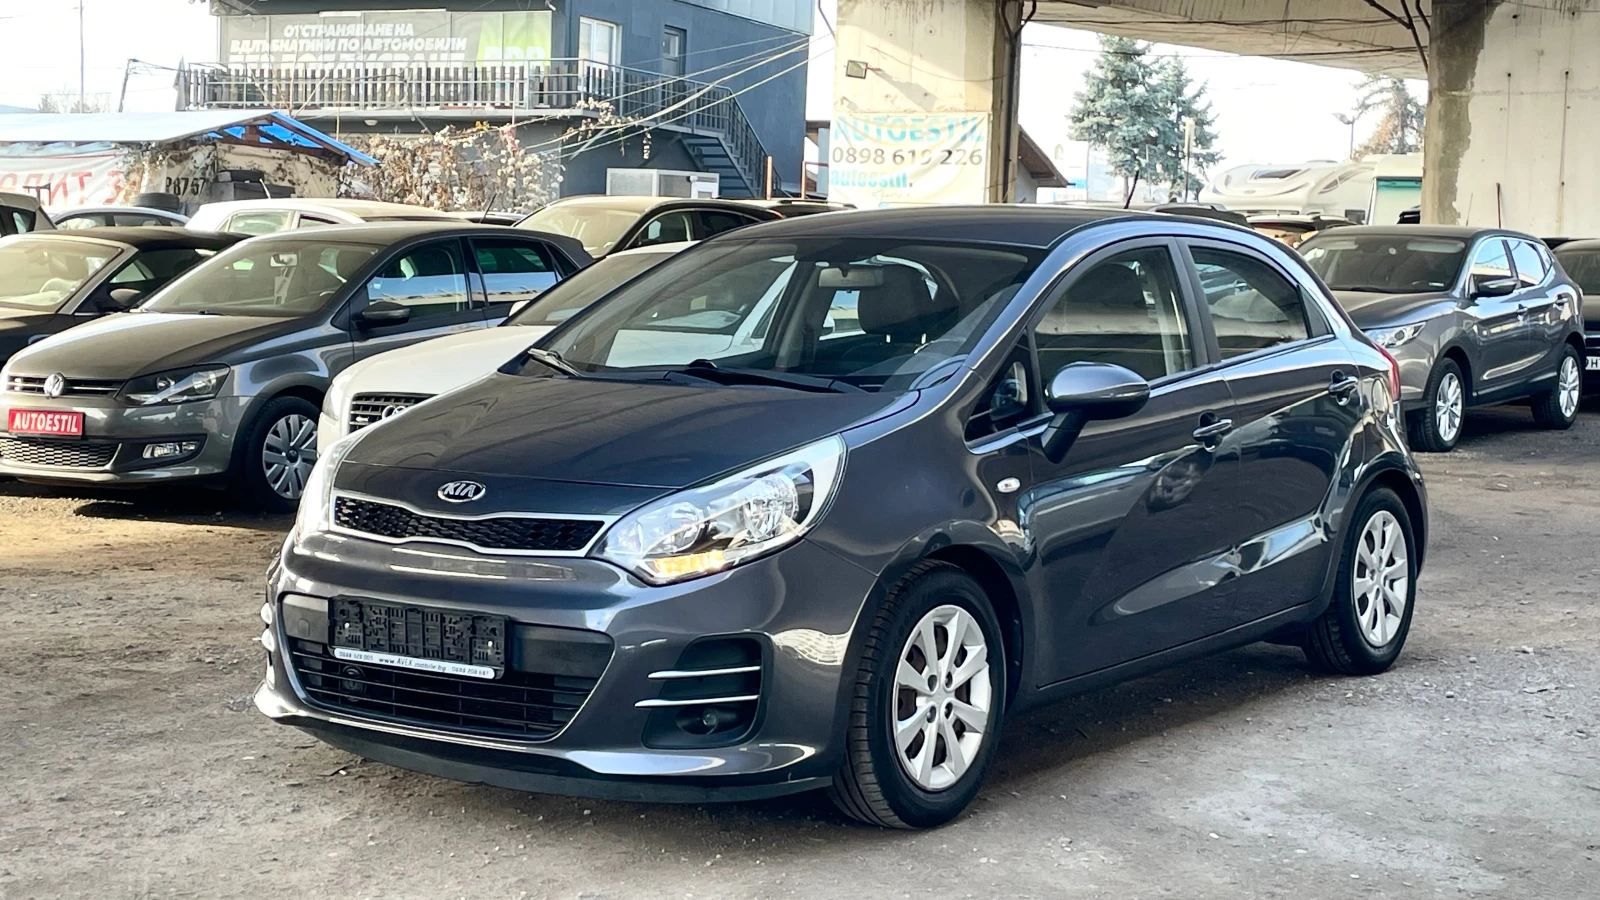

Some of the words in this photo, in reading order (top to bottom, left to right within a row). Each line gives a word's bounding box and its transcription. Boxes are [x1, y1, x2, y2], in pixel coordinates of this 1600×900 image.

[284, 24, 393, 38] ОТСТРАНЯВАНЕ
[394, 23, 415, 36] НА
[230, 39, 337, 54] ВДЛЪБНАТИНИ
[337, 39, 361, 51] ПО
[363, 38, 468, 51] АВТОМОБИЛИ
[832, 147, 886, 165] 0898
[940, 148, 983, 166] 226
[13, 412, 79, 433] AUTOESTIL
[443, 482, 477, 498] KIA
